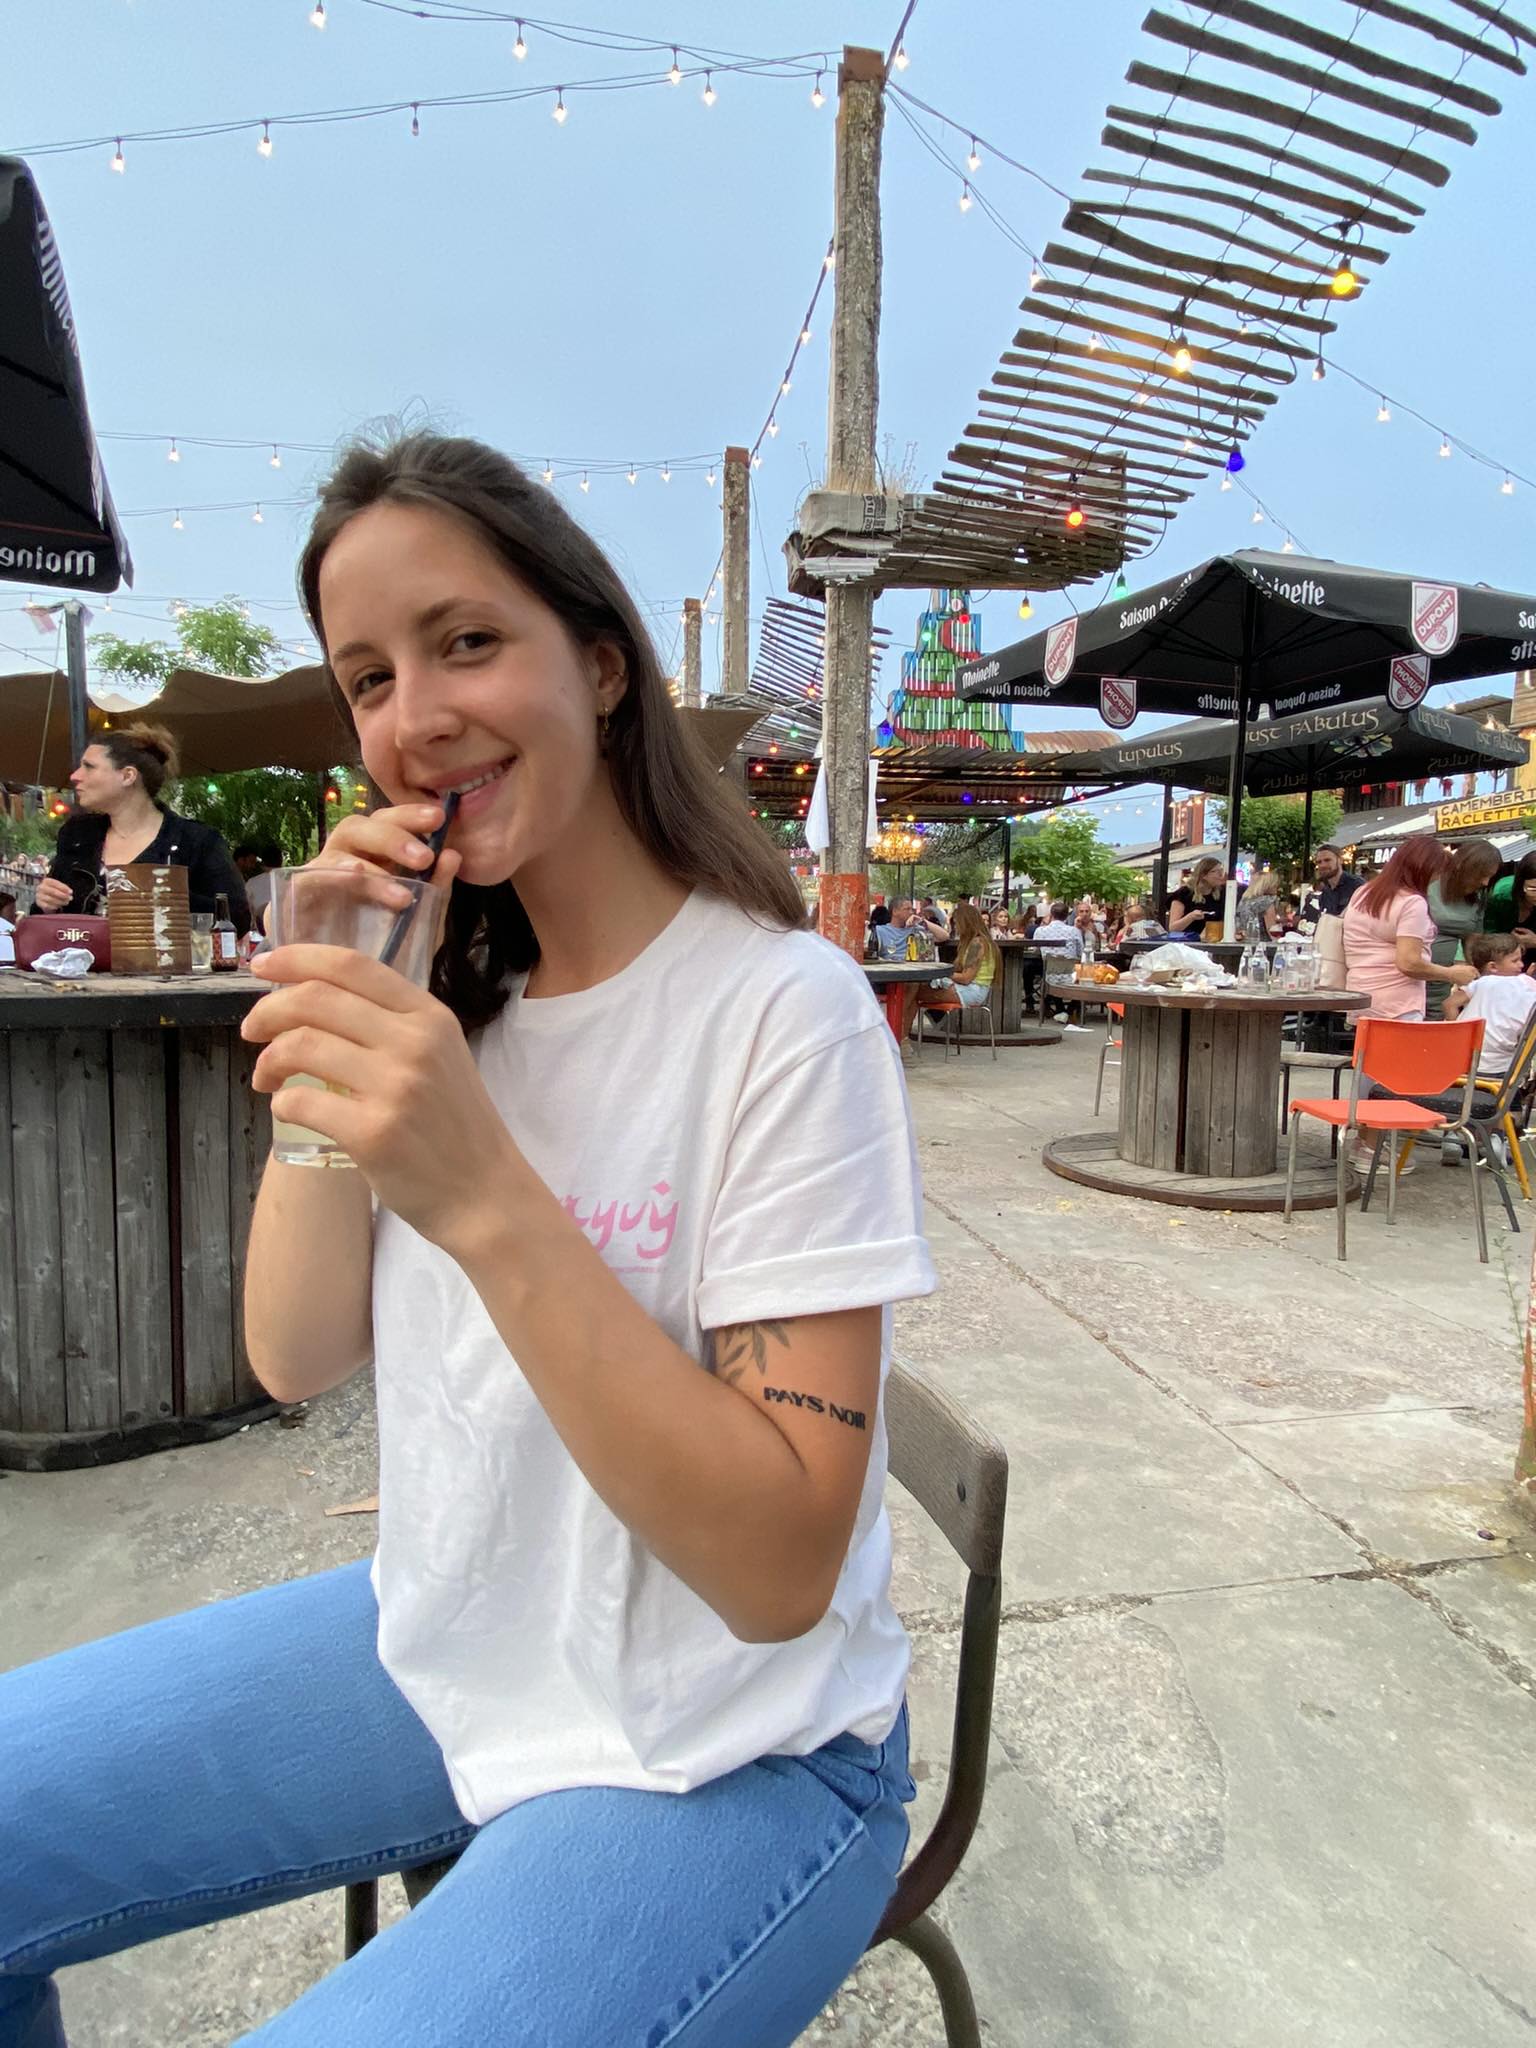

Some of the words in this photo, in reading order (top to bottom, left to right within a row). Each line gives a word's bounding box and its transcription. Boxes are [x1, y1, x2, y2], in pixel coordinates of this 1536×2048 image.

[1119, 604, 1157, 629] Saison
[1418, 594, 1453, 636] DUPONT
[1519, 611, 1536, 629] Sa
[962, 661, 1000, 689] Moinette
[764, 1386, 825, 1413] PAYS
